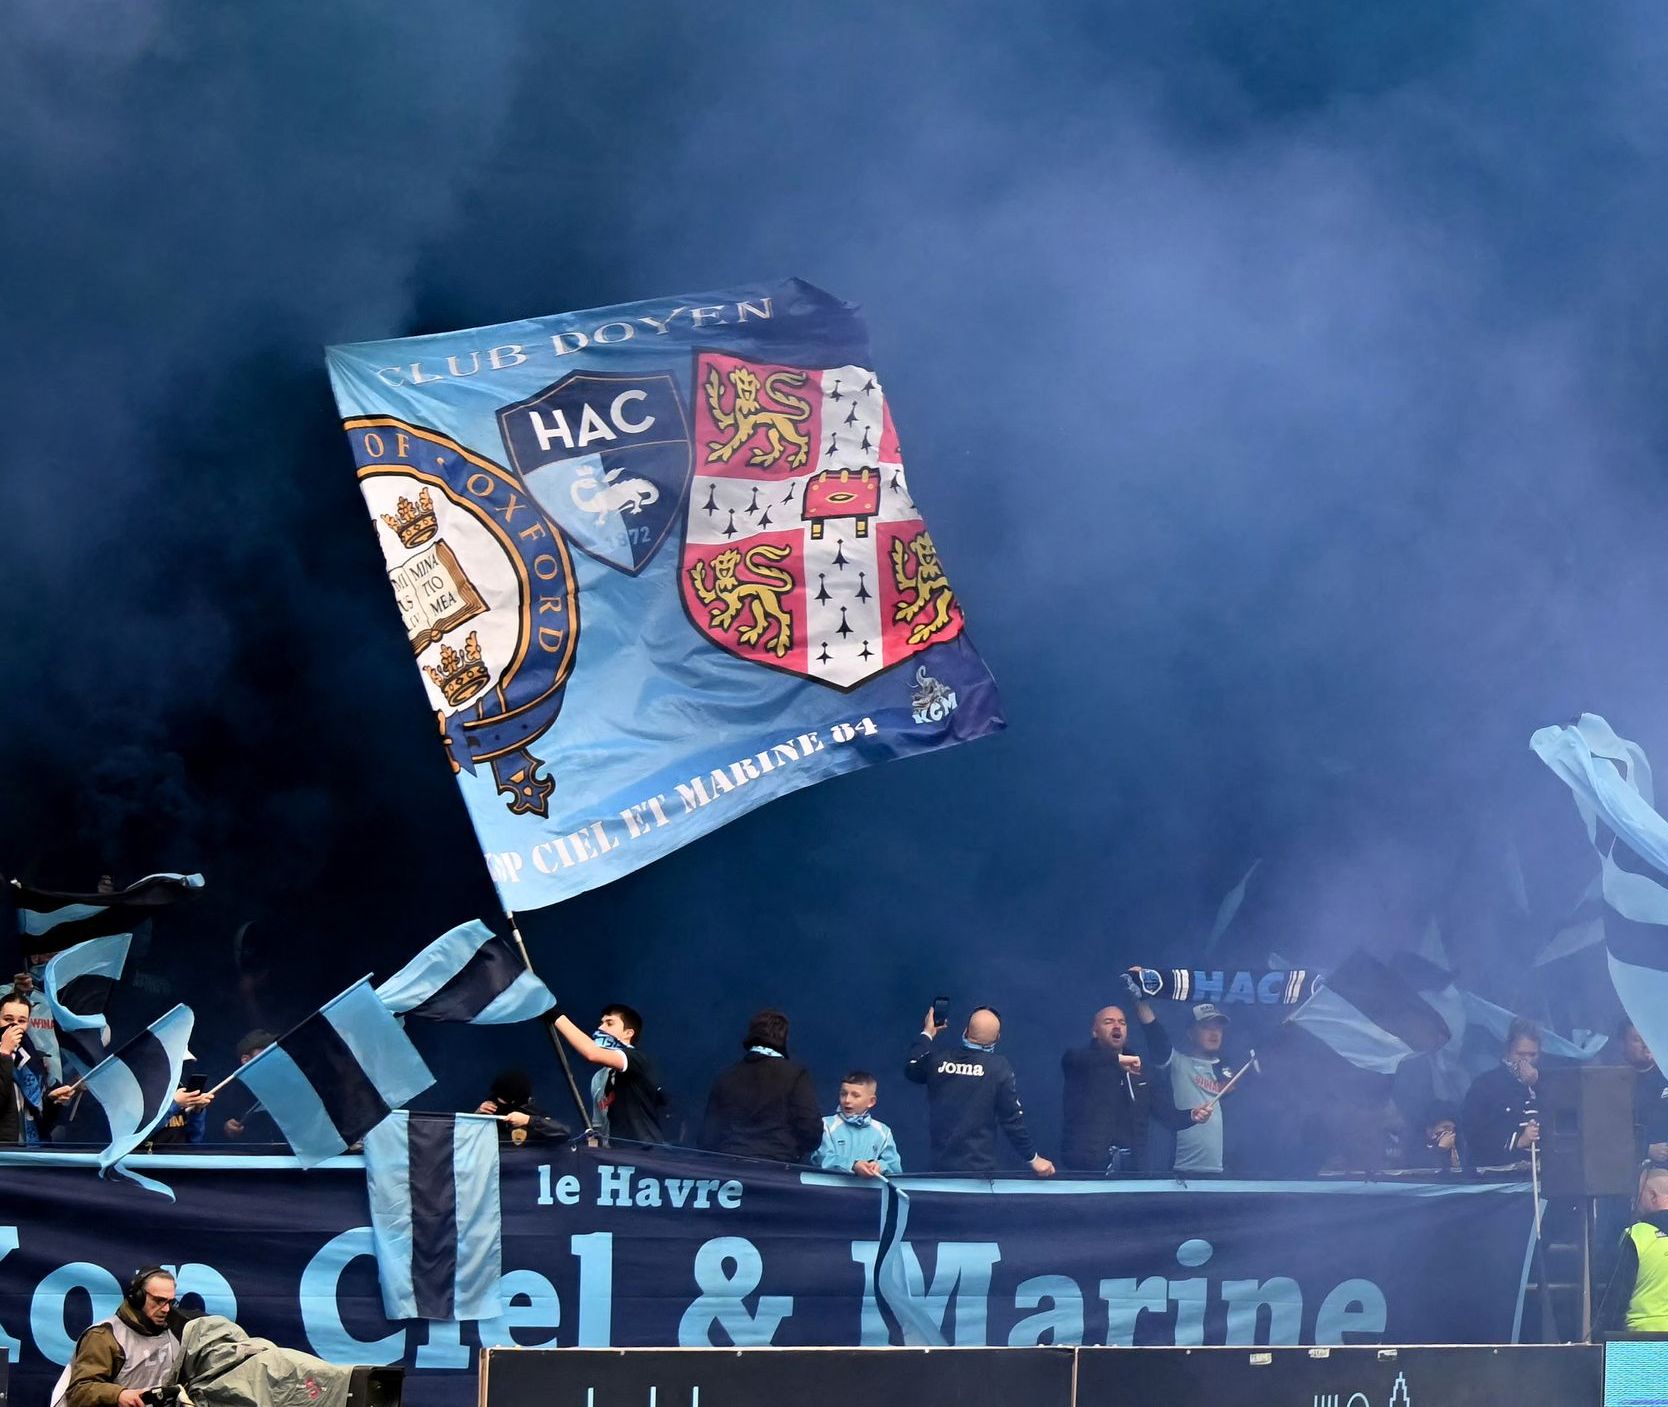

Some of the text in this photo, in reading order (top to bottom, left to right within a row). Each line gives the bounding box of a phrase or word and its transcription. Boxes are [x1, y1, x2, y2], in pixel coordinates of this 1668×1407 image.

[376, 297, 773, 387] CLUB DOYEN
[529, 389, 656, 451] HAC
[363, 432, 565, 654] OF OXFORD
[409, 553, 440, 581] MINA
[421, 575, 444, 597] TIO
[430, 592, 457, 616] MEA
[531, 821, 619, 874] CIEL
[620, 794, 671, 840] ET
[674, 731, 825, 814] MARINE
[830, 717, 878, 743] 84
[1192, 969, 1286, 1005] HAC
[537, 1164, 743, 1209] le Havre
[678, 1236, 794, 1347] &
[852, 1238, 1388, 1347] Marine
